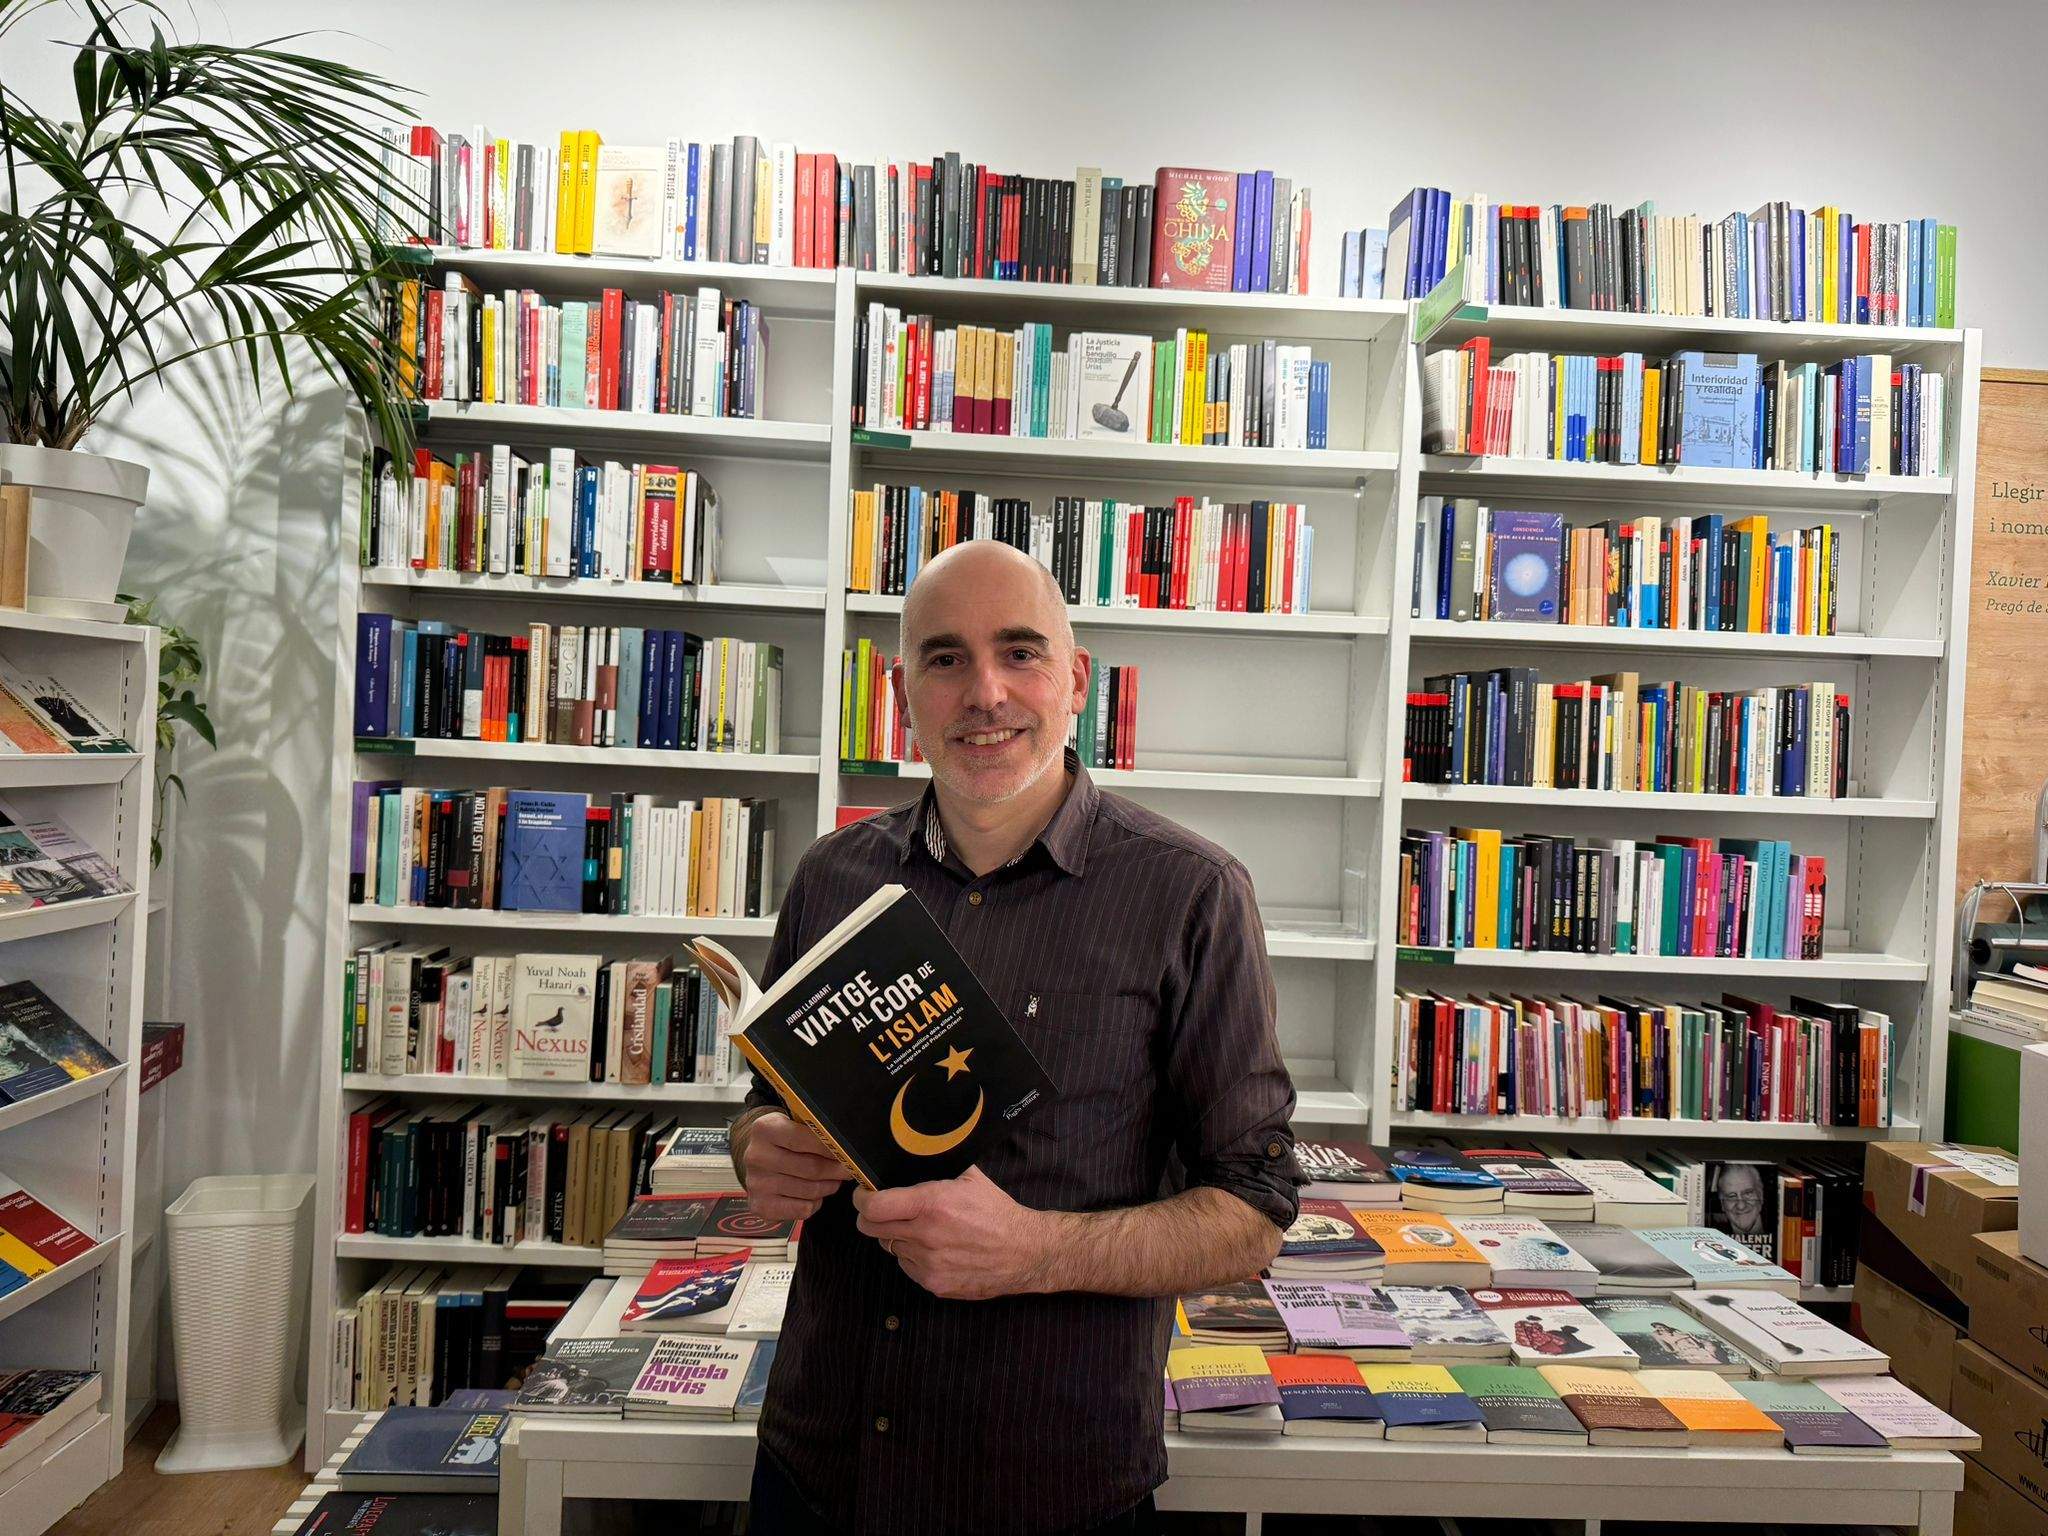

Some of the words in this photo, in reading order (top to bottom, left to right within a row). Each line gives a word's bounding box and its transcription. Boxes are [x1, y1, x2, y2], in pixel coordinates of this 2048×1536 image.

[1168, 172, 1203, 181] MICHAEL
[1206, 174, 1230, 183] WOOD
[1164, 221, 1229, 241] CHINA
[1096, 339, 1120, 347] Justicia
[1692, 373, 1748, 385] Interioridad
[1703, 385, 1743, 395] realidad
[1992, 482, 2045, 503] Llegir
[649, 501, 661, 556] imperialismo
[659, 518, 669, 551] catalán
[1989, 517, 1996, 533] i
[649, 556, 658, 567] El
[1986, 570, 2042, 589] Xavier
[1986, 598, 2022, 615] Pregó
[2026, 600, 2042, 614] de
[1823, 740, 1831, 755] GOCE
[472, 796, 487, 834] DALTON
[471, 834, 484, 852] LOS
[1760, 850, 1770, 883] GOLDIN
[1777, 850, 1787, 883] GOLDIN
[527, 965, 554, 977] Yuval
[558, 967, 587, 978] Noah
[540, 978, 571, 990] Harari
[785, 1009, 804, 1026] JORDI
[801, 984, 832, 1013] LLAONART
[850, 1011, 874, 1033] AL
[869, 974, 923, 1023] COR
[917, 961, 936, 986] DE
[793, 970, 880, 1046] VIATGE
[630, 989, 648, 1055] Cristiandad
[868, 982, 959, 1063] L'ISLAM
[471, 1019, 488, 1060] Nexus
[493, 1020, 509, 1060] Nexus
[514, 1029, 588, 1053] Nexus
[911, 1034, 930, 1050] política
[929, 1026, 940, 1037] dels
[921, 1041, 930, 1051] del
[946, 1015, 963, 1030] Orient
[1760, 1062, 1770, 1095] ÚNICAS
[466, 1136, 476, 1187] OCCIDENTE
[552, 1192, 563, 1231] ESCITAS
[1271, 1284, 1326, 1294] Mujeres
[1276, 1292, 1328, 1300] cultura
[1281, 1301, 1290, 1309] y
[1293, 1299, 1342, 1309] política
[389, 1300, 398, 1341] REVOLUCIONES
[409, 1301, 419, 1342] REVOLUCIONES
[389, 1342, 397, 1353] LAS
[409, 1343, 417, 1355] LAS
[655, 1348, 739, 1361] pensamiento
[659, 1340, 712, 1351] Mujeres
[388, 1363, 396, 1375] ERA
[408, 1365, 416, 1377] ERA
[641, 1361, 731, 1382] Angela
[635, 1377, 709, 1396] Davis
